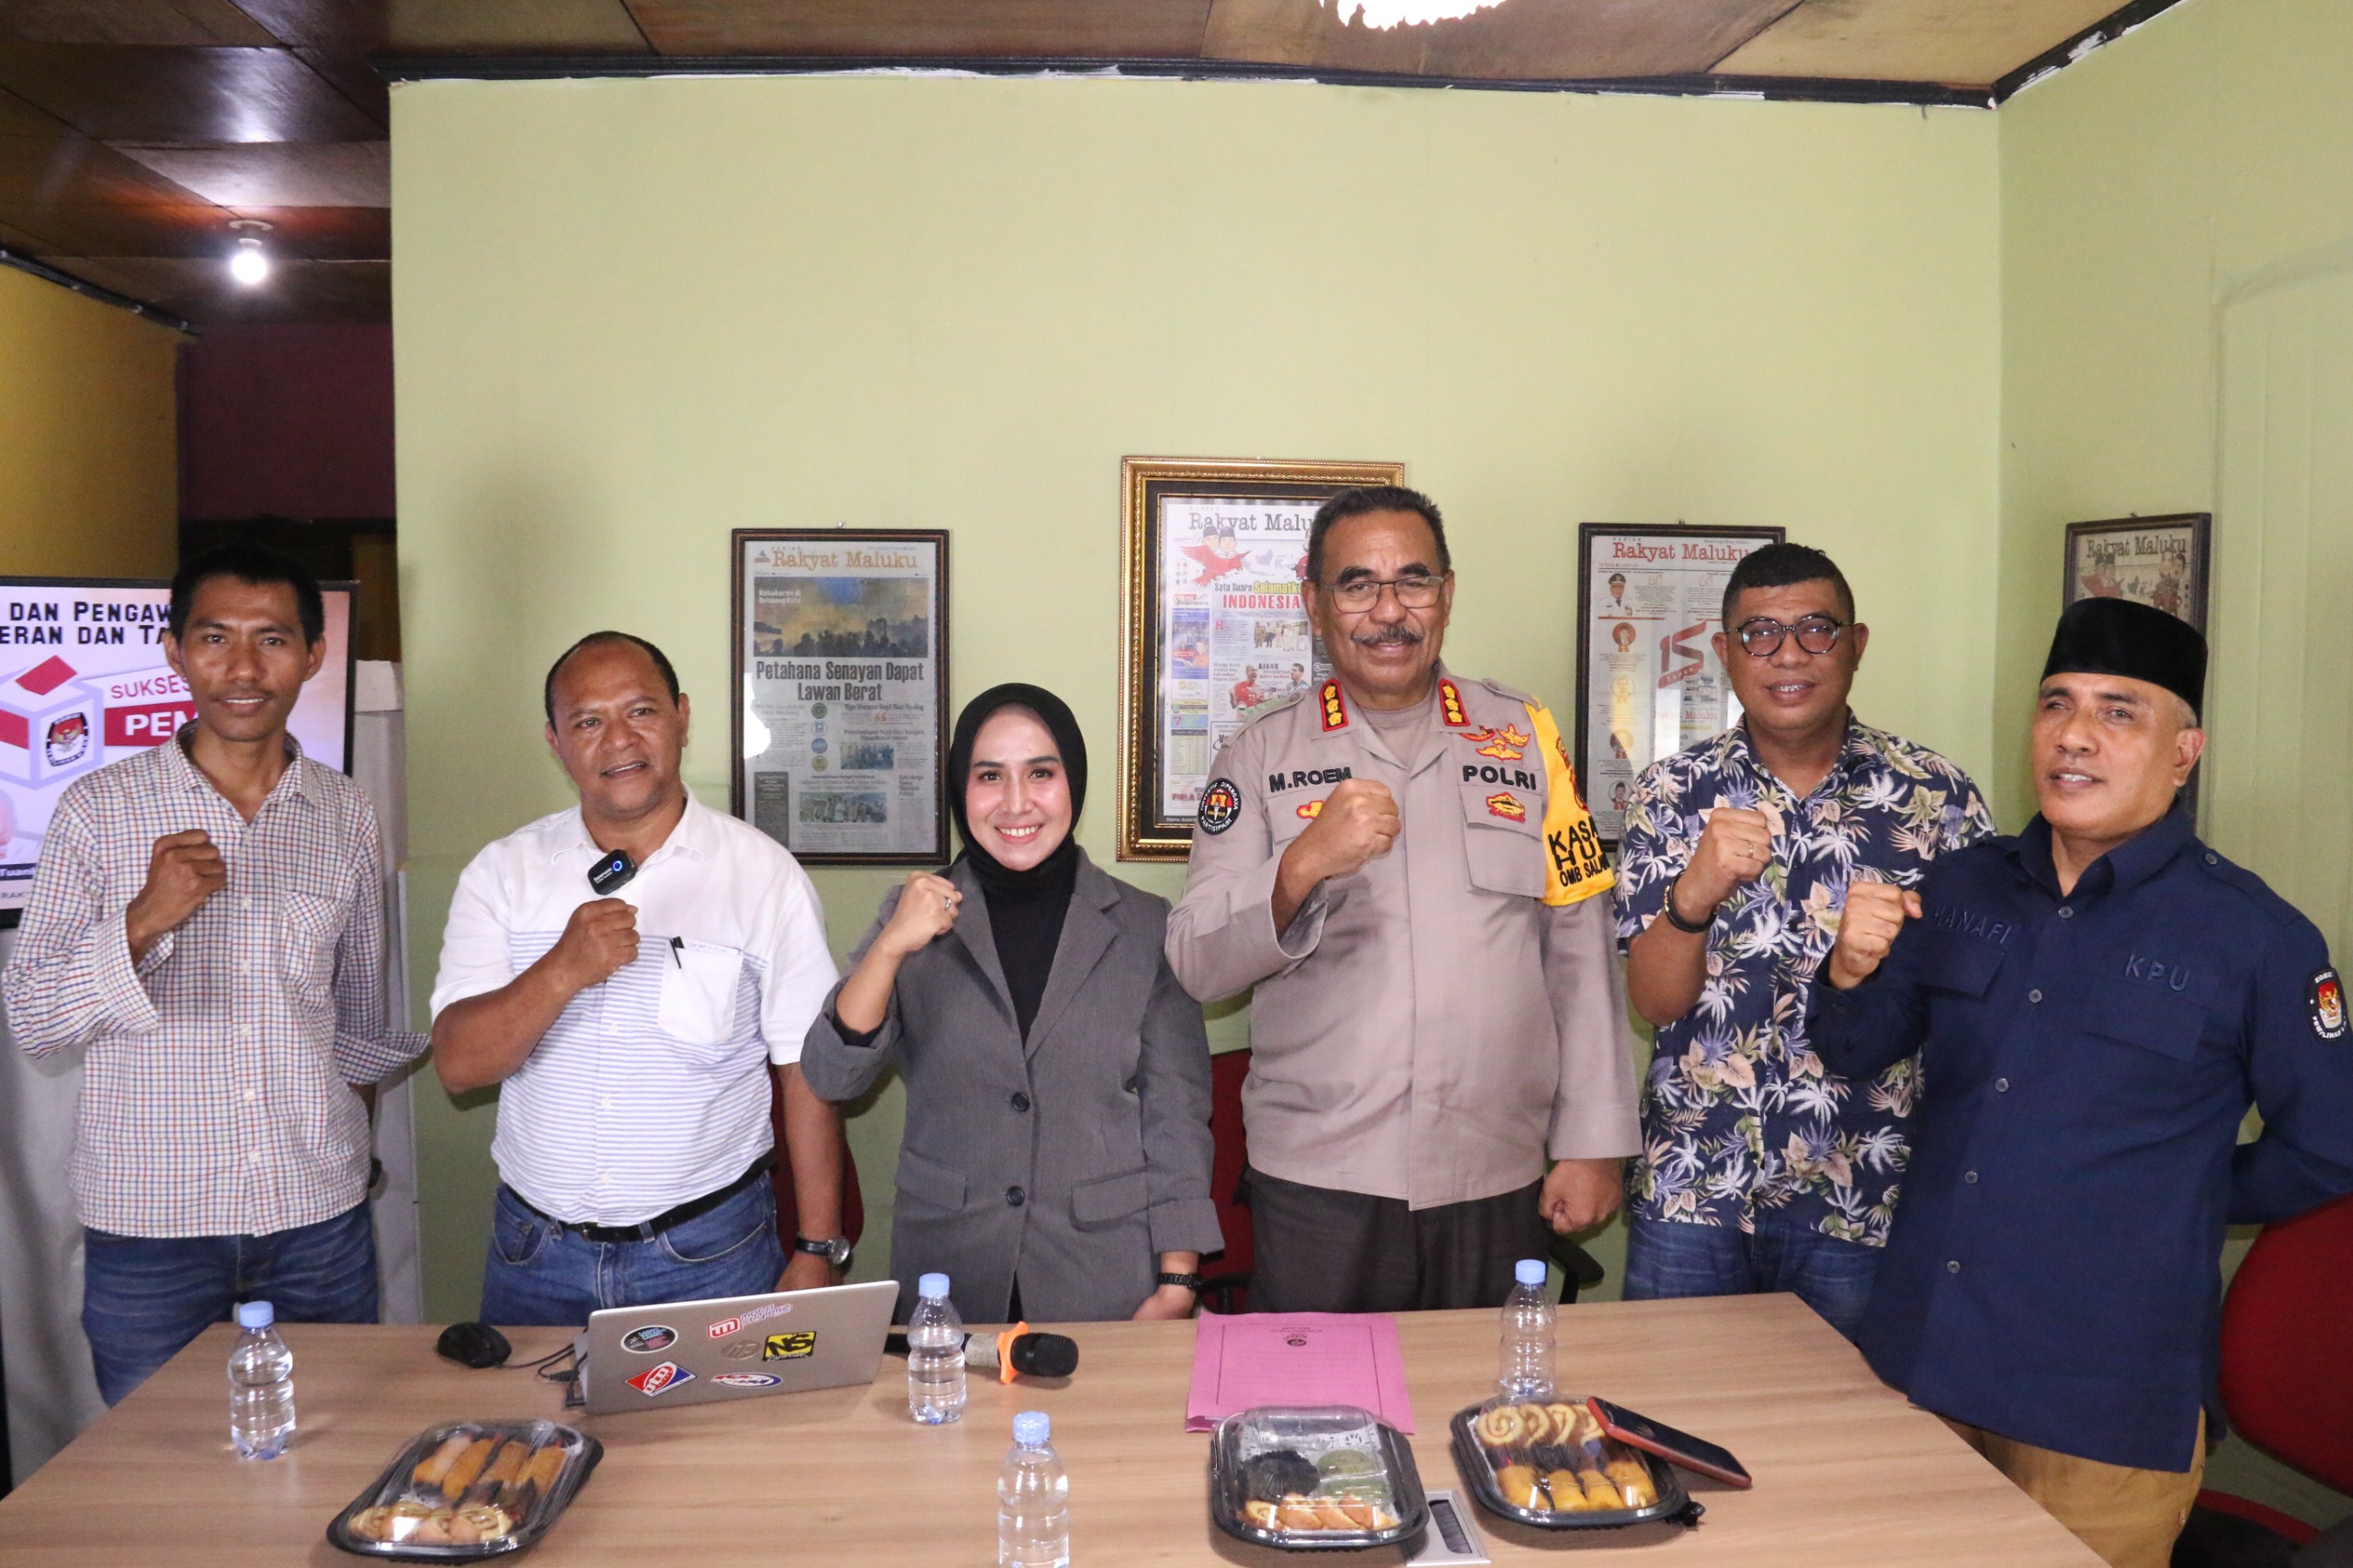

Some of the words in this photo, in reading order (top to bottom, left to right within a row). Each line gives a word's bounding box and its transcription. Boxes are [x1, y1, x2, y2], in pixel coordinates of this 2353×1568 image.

[1188, 513, 1257, 530] Rakyat
[1613, 541, 1676, 562] Rakyat
[1682, 543, 1749, 561] Maluku
[2086, 539, 2130, 558] Rakyat
[2134, 534, 2187, 556] Maluku
[772, 551, 838, 571] Rakyat
[845, 551, 918, 569] Maluku
[1215, 583, 1231, 592] Satu
[1232, 583, 1253, 592] Suara
[10, 602, 59, 621] DAN
[1222, 594, 1301, 609] INDONESIA
[78, 627, 124, 644] DAN
[756, 661, 821, 680] Petahana
[826, 661, 882, 683] Senayan
[885, 662, 925, 683] Dapat
[797, 682, 841, 700] Lawan
[844, 683, 883, 700] Berat
[1268, 767, 1352, 792] M.ROEM
[1462, 766, 1537, 790] POLRI
[1560, 865, 1583, 887] OMB
[1934, 905, 2012, 945] HANAFI
[2125, 953, 2190, 992] KPU
